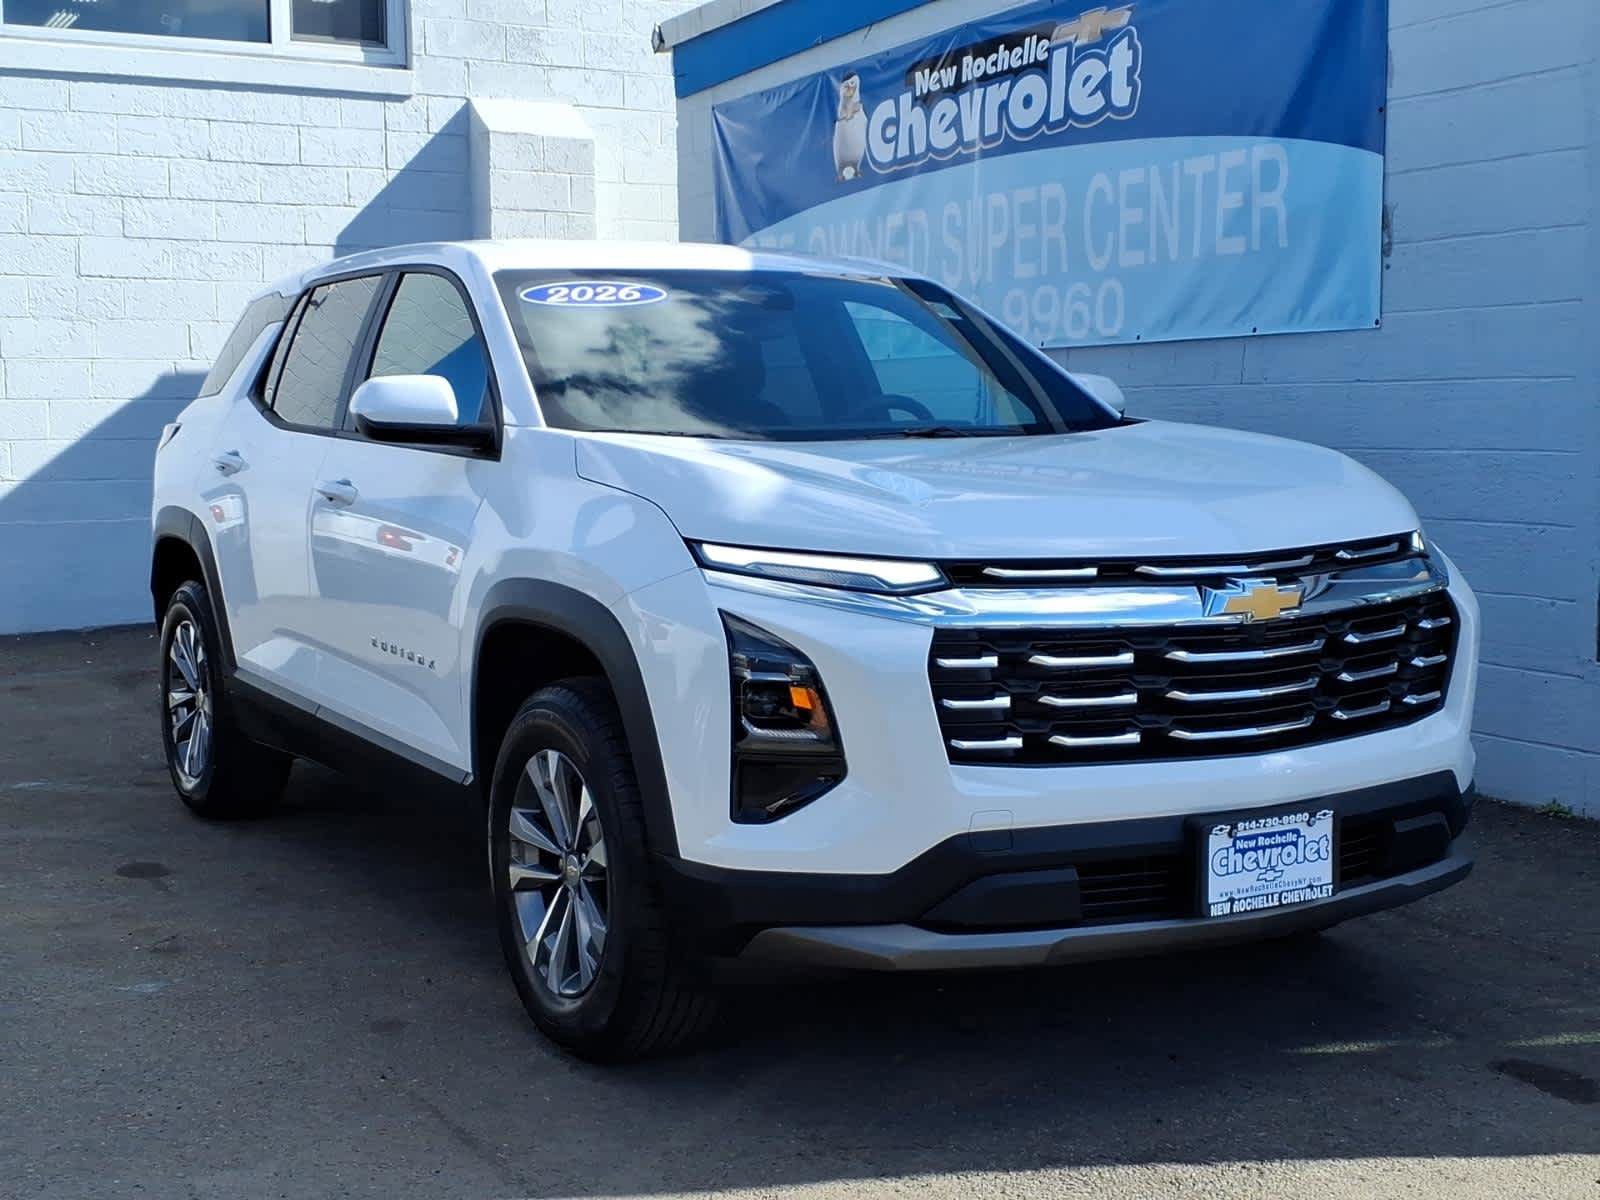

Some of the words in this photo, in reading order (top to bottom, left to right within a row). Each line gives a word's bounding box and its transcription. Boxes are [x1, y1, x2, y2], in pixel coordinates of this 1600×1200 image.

[914, 64, 957, 97] New
[961, 35, 1050, 84] Rochelle
[868, 36, 1133, 163] Chevrolet
[942, 181, 1068, 289] SUPER
[1084, 143, 1289, 272] CENTER
[547, 286, 641, 303] 2026
[1211, 835, 1329, 876] Chevrolet
[1235, 839, 1256, 850] New
[1258, 833, 1297, 846] Rochelle
[1210, 902, 1231, 917] NEW
[1233, 894, 1280, 912] ROCHELLE
[1281, 885, 1333, 904] CHEVROLET
